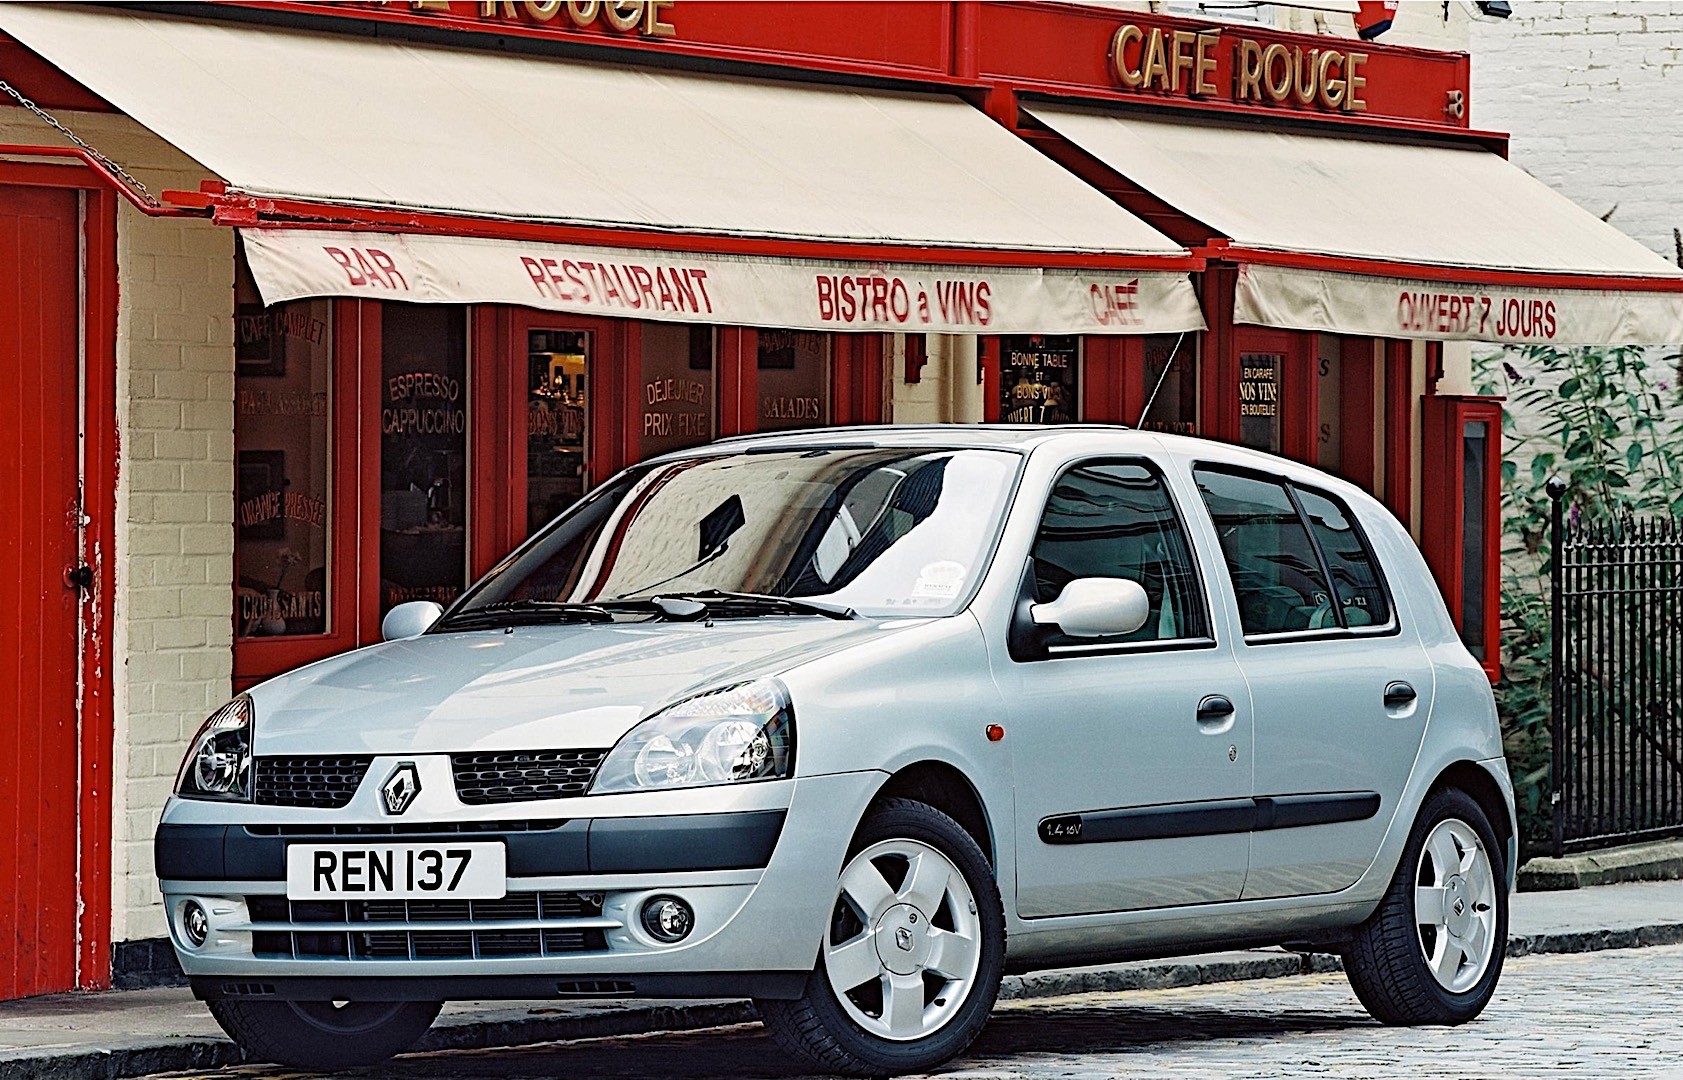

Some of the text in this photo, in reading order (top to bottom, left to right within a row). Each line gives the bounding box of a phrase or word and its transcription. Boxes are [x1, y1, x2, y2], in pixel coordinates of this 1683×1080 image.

[1113, 25, 1368, 111] CAFÉ ROUGE
[322, 246, 409, 291] BAR
[519, 256, 712, 314] RESTAURANT
[816, 275, 910, 323] BISTRO
[936, 280, 992, 326] VINS
[1090, 278, 1145, 326] CAFÉ
[1399, 291, 1556, 339] OUVERT 7 JOURS
[1011, 352, 1068, 368] BONNE TABLE
[1244, 367, 1252, 379] EN
[388, 372, 459, 402] ESPRESSO
[647, 376, 705, 405] DÉJEUNER
[1035, 371, 1044, 382] ET
[1016, 385, 1040, 400] BONS
[1239, 382, 1256, 401] NOS
[382, 409, 465, 434] CAPPUCCINO
[764, 397, 819, 420] SALADES
[644, 412, 706, 437] PRIX FIXE
[241, 490, 325, 528] ORANGE PRESSÉE
[1046, 823, 1064, 836] 1.4
[313, 849, 472, 892] REN 137
